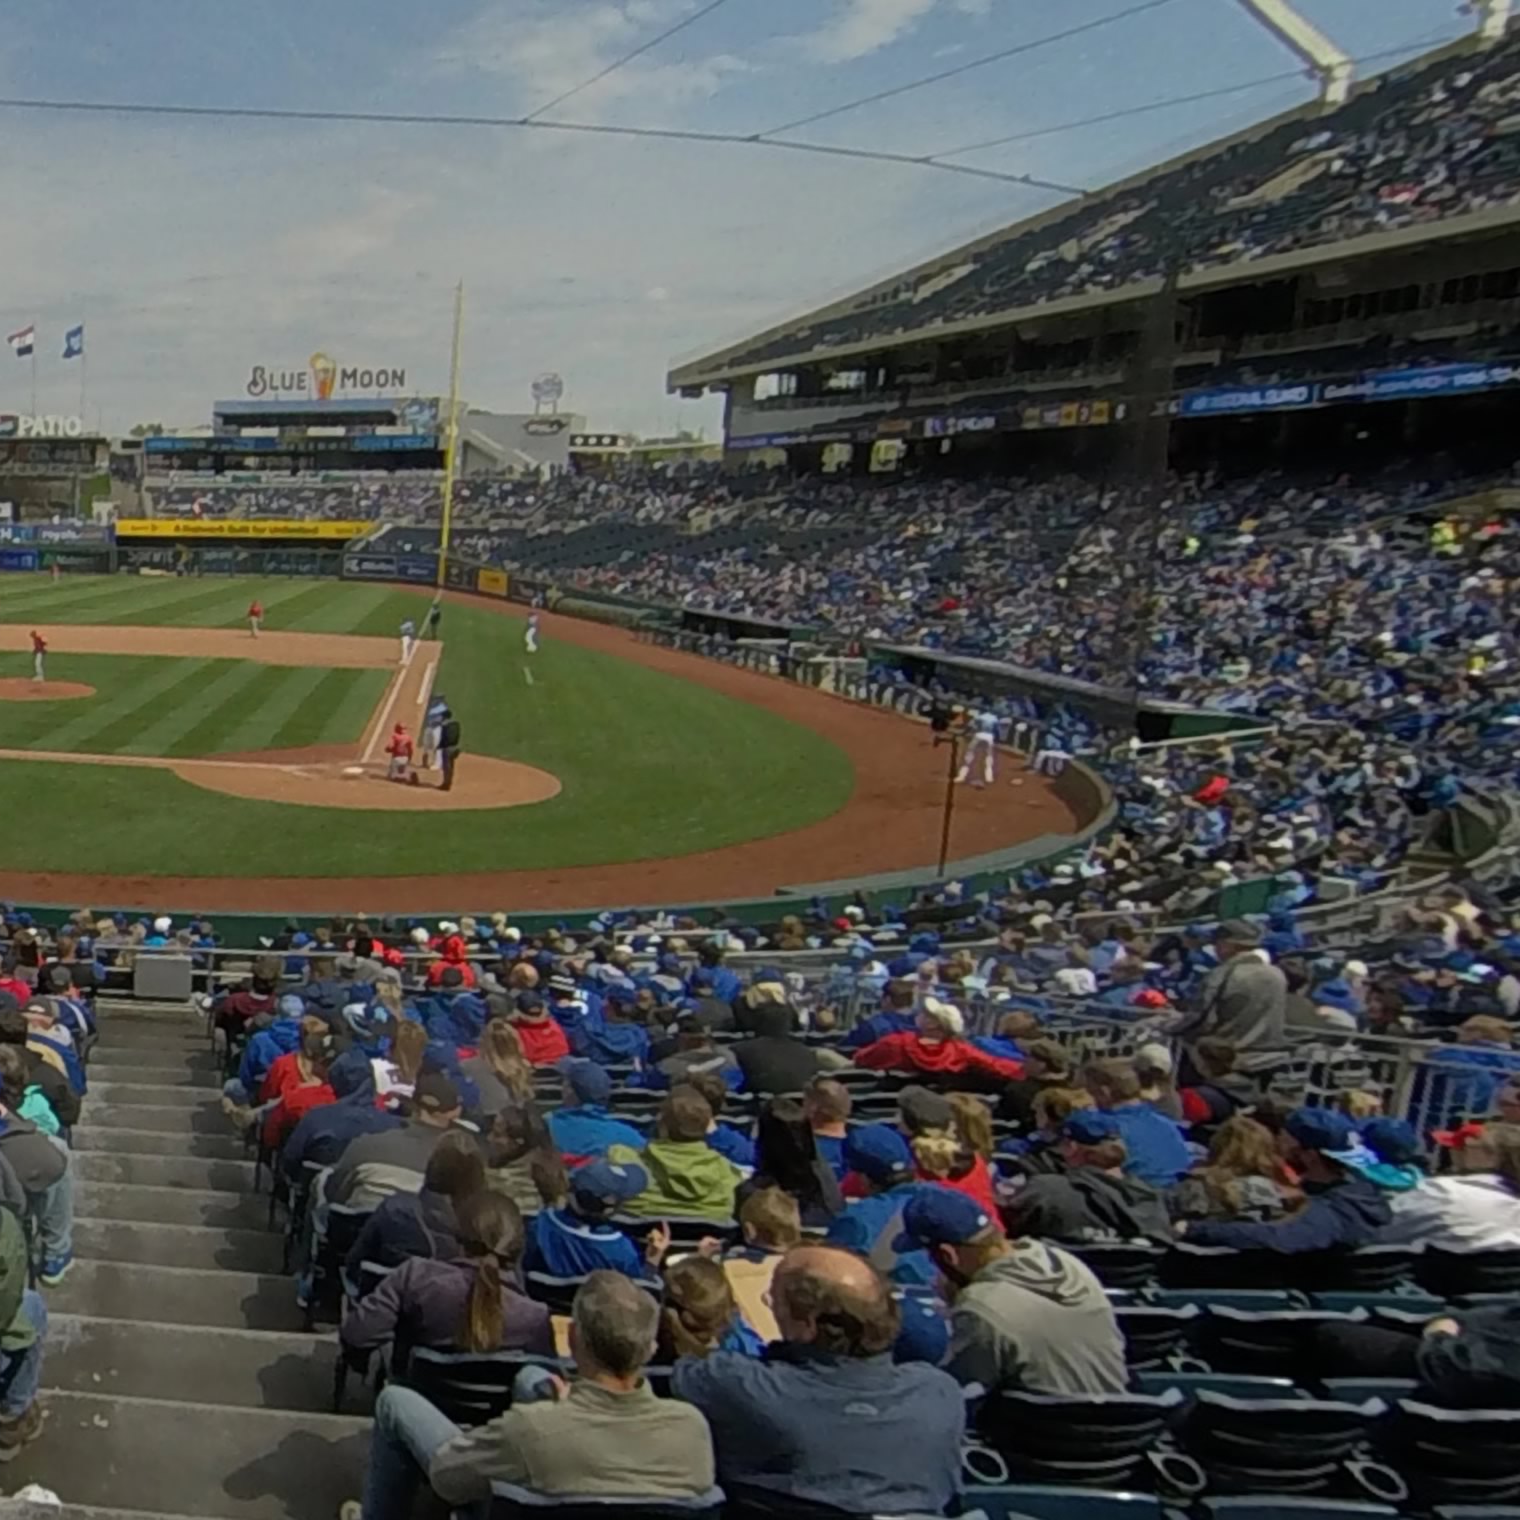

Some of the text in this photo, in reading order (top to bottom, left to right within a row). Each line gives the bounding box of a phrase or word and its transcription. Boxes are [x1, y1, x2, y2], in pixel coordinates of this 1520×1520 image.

[247, 366, 405, 396] BLUE MOON
[18, 415, 81, 438] PATIO
